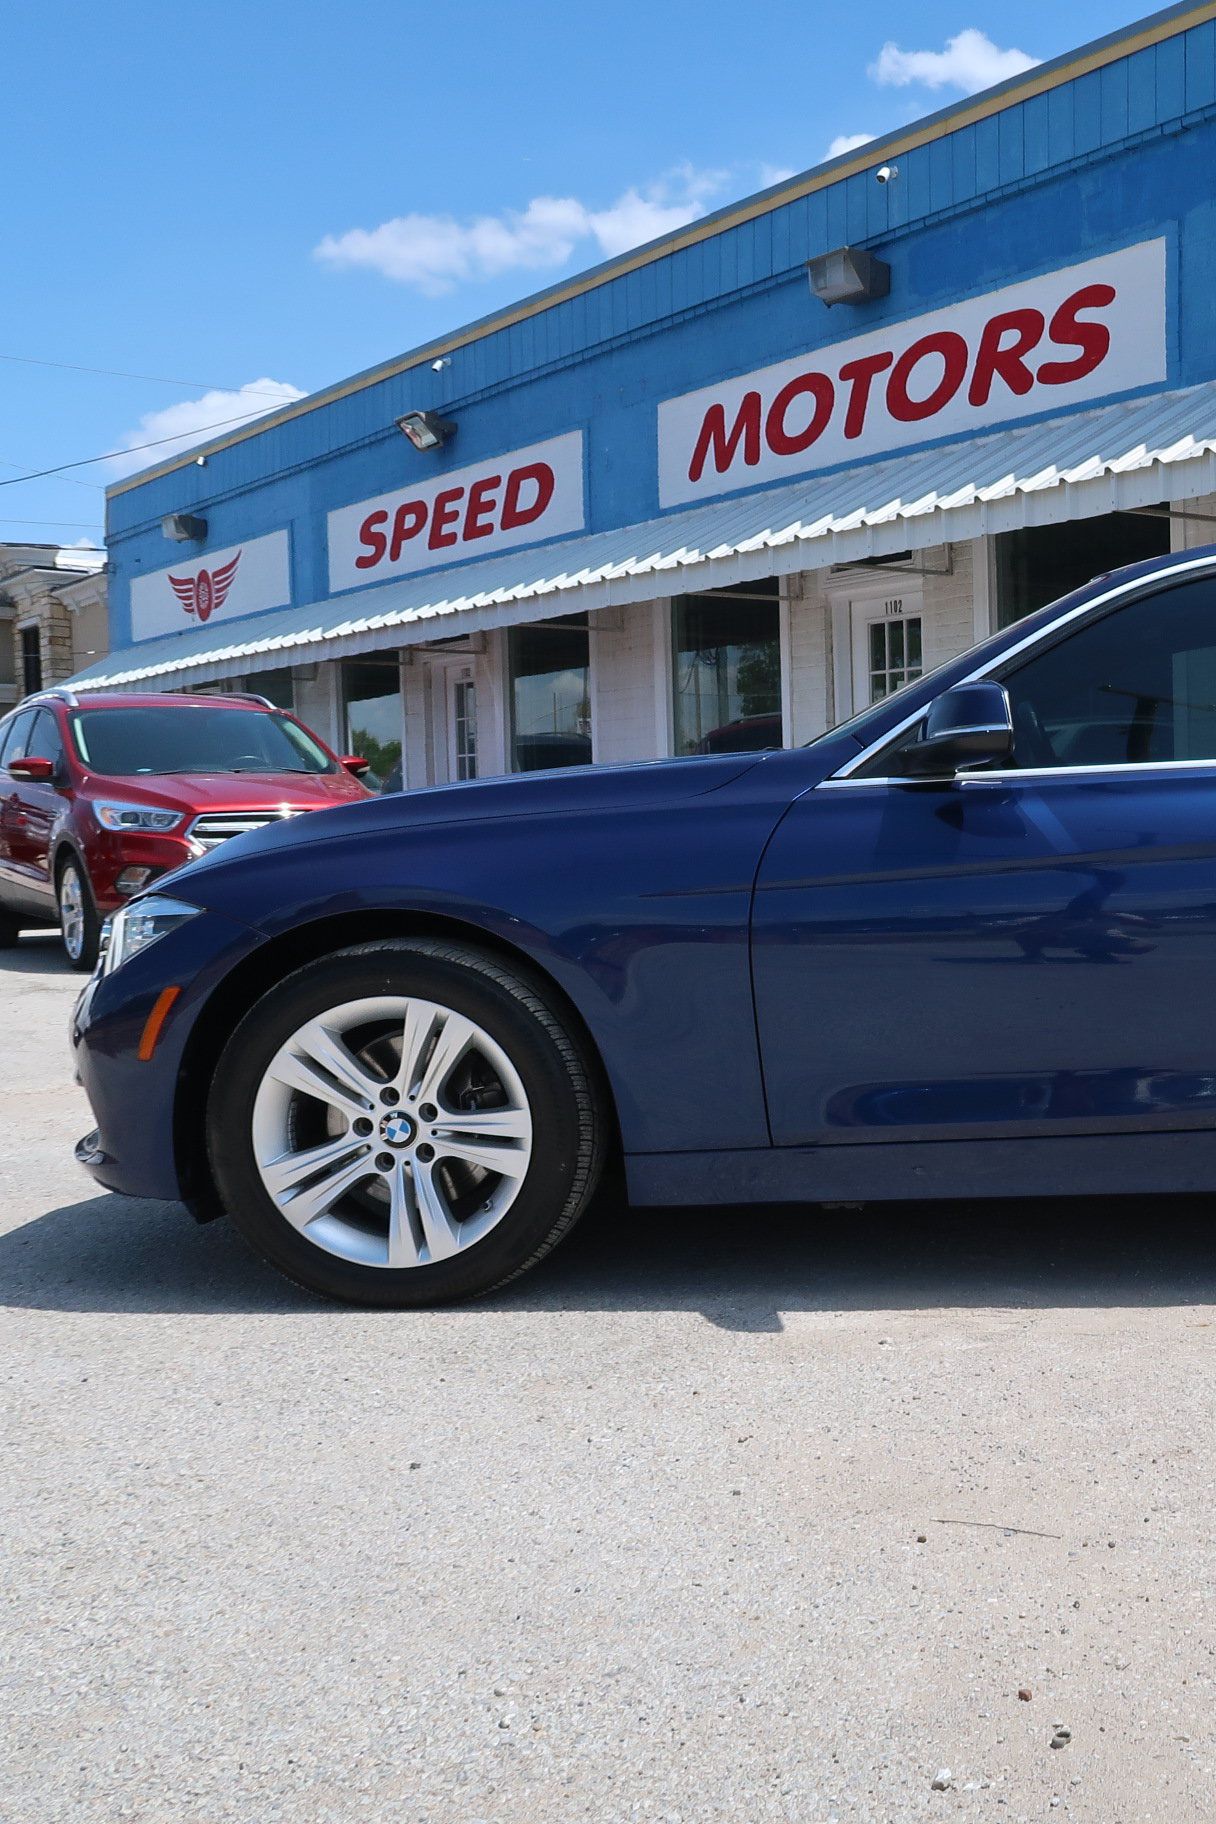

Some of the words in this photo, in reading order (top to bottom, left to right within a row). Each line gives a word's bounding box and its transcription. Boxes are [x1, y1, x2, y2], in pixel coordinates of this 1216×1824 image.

[690, 284, 1115, 480] MOTORS
[358, 463, 553, 567] SPEED
[884, 599, 903, 614] 1102
